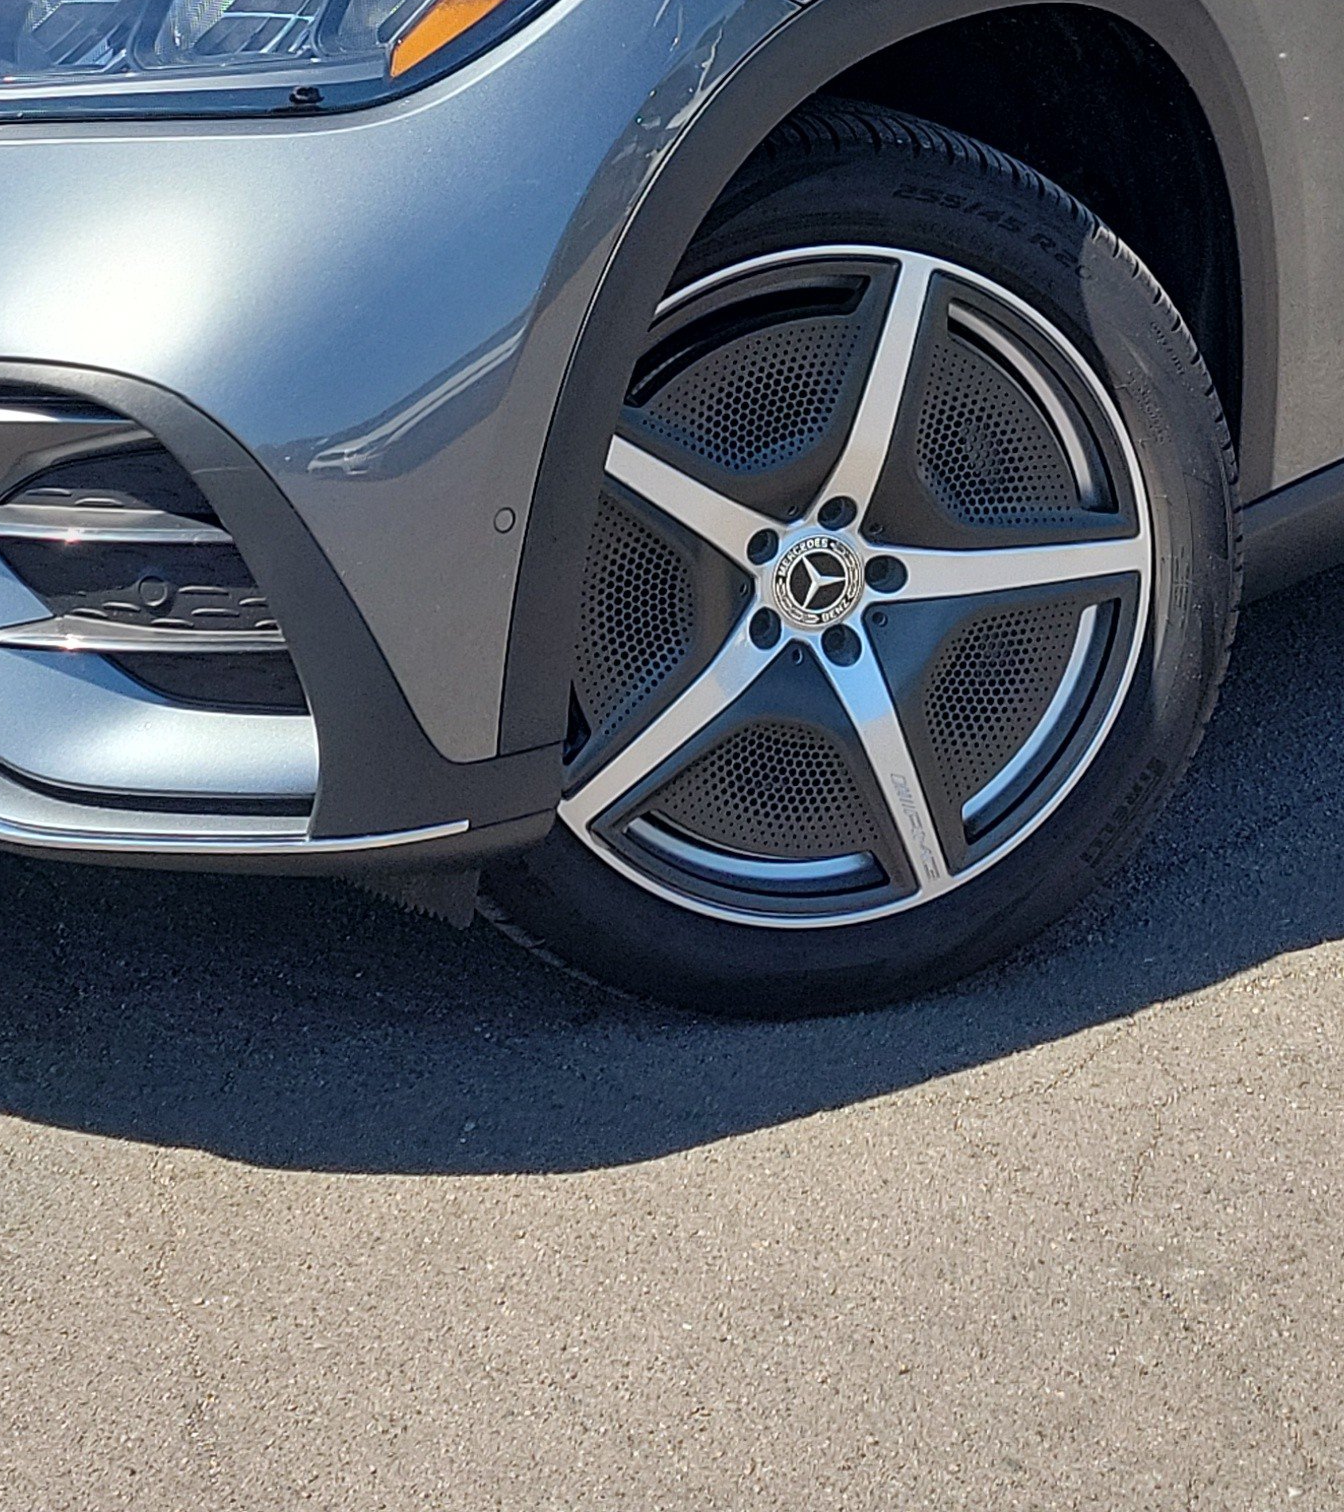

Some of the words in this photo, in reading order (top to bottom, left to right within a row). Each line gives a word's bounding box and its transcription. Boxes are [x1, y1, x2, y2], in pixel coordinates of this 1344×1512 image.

[891, 181, 1028, 233] 255/45
[777, 537, 830, 577] MERCEDES
[819, 599, 851, 623] BENZ
